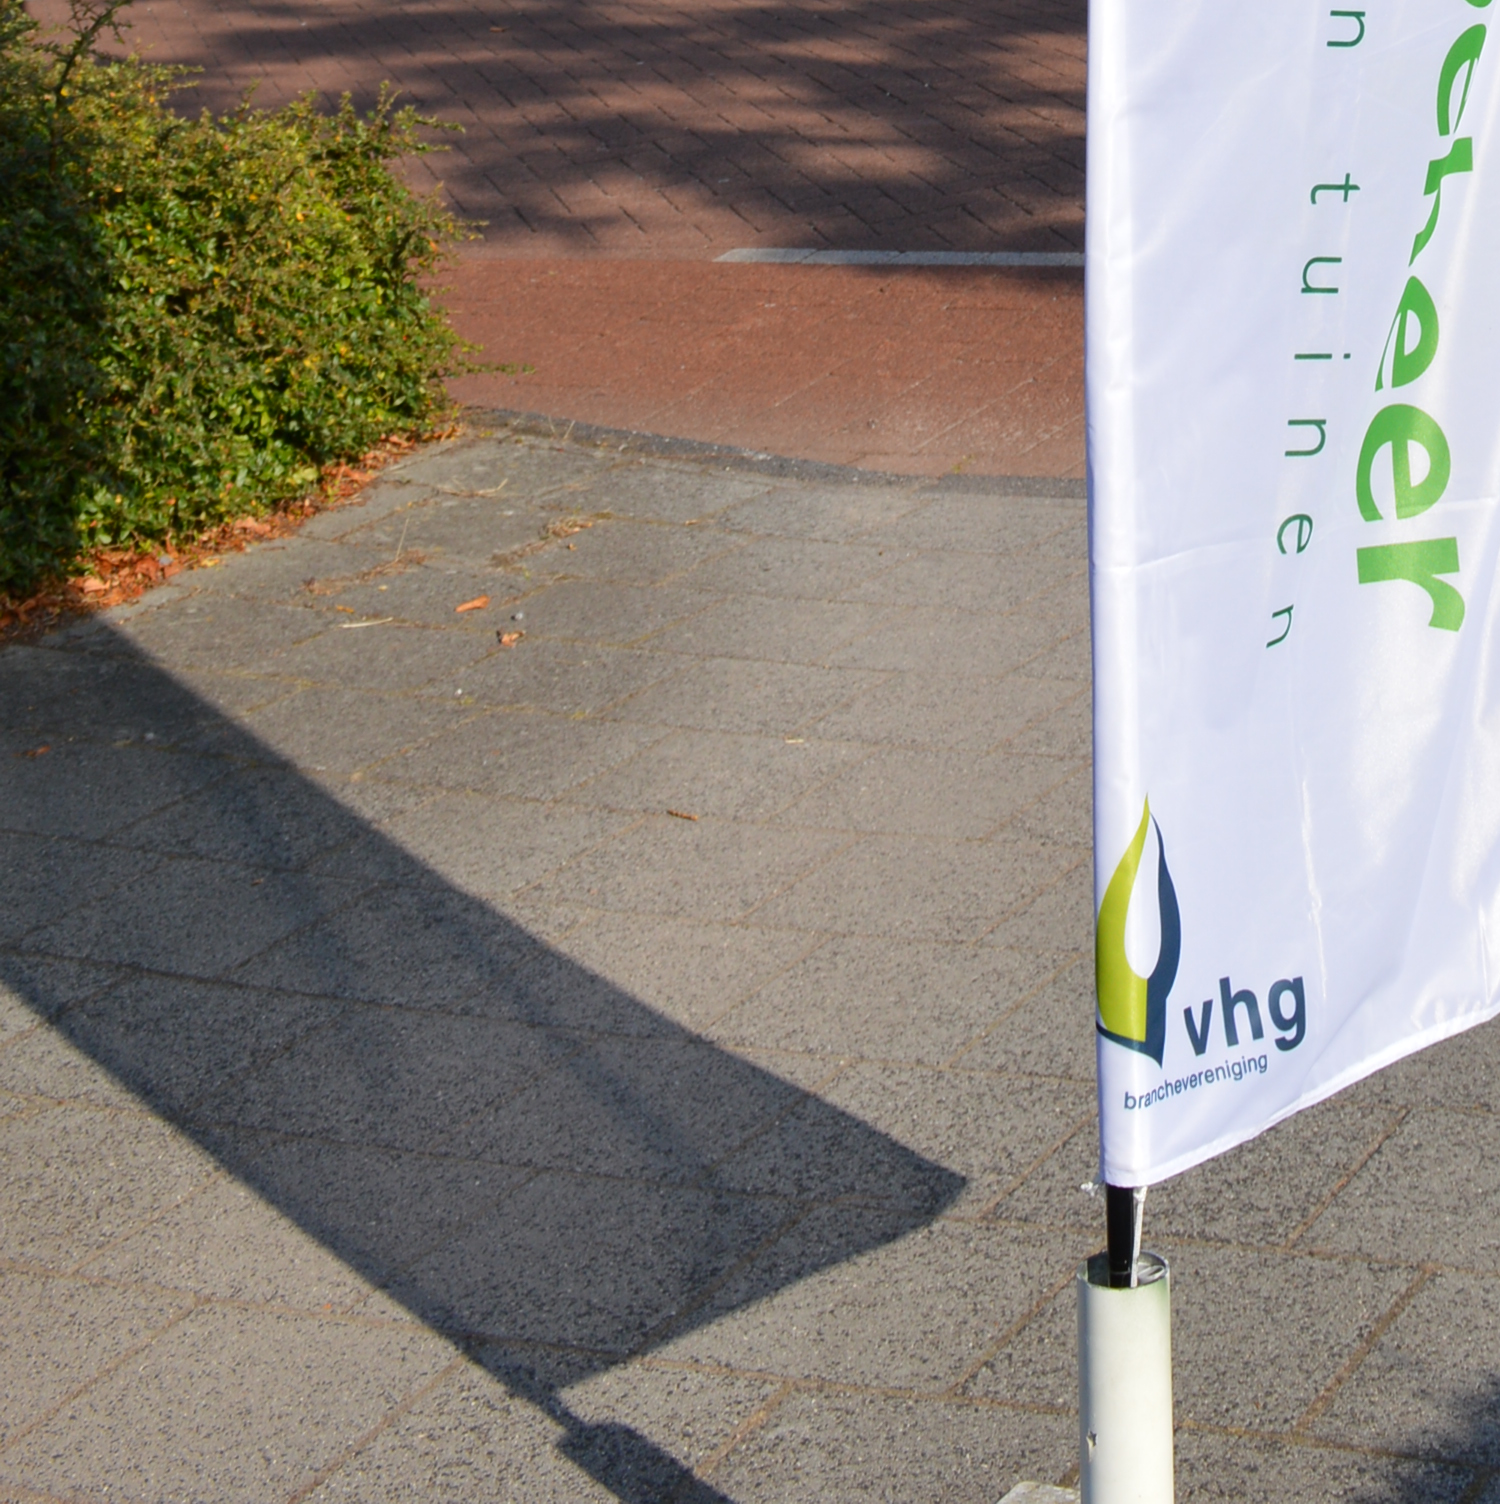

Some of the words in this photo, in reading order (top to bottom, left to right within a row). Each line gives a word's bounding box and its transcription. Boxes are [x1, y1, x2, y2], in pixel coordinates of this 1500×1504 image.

[1264, 171, 1361, 651] tuinen
[1183, 976, 1306, 1056] vhg
[1123, 1054, 1269, 1110] branchevereniging
